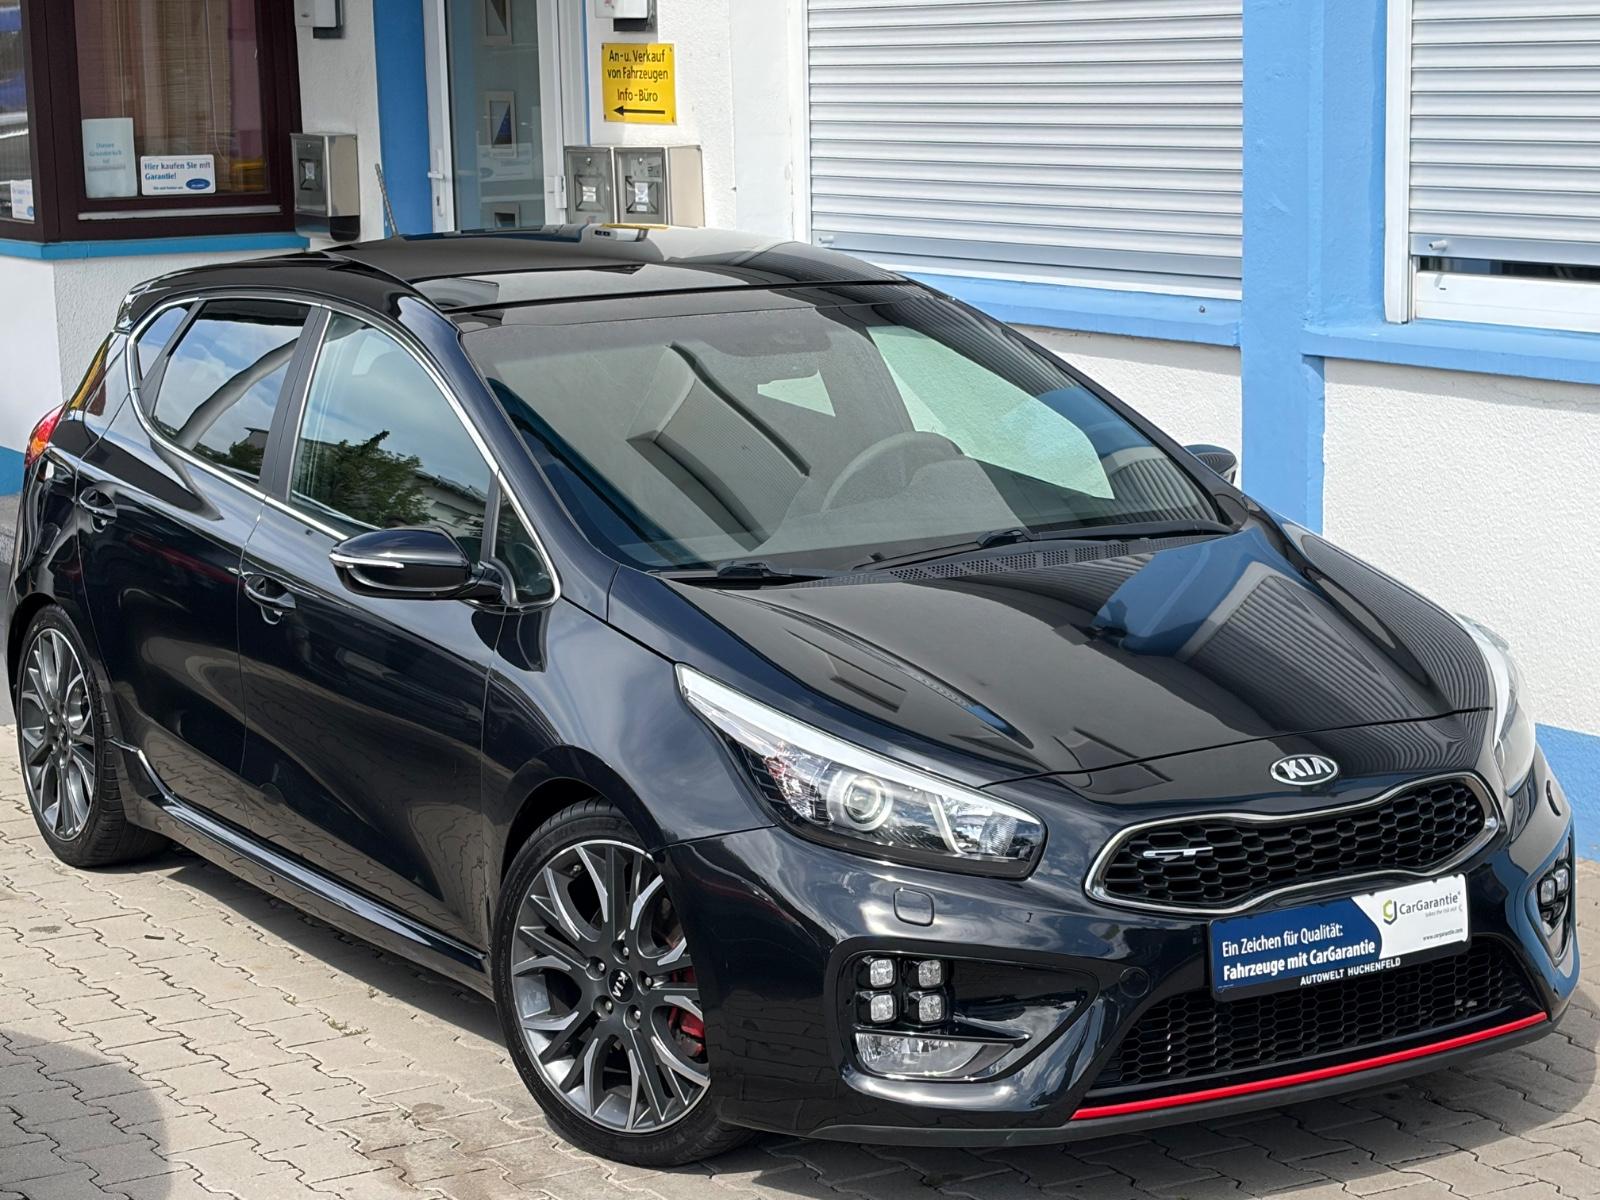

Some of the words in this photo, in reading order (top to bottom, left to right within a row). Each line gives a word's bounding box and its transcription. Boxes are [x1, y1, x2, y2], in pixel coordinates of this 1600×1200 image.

[632, 48, 666, 63] Verkauf
[607, 68, 621, 79] von
[622, 66, 669, 83] Fahrzeugen
[144, 162, 159, 170] Hier
[160, 162, 185, 170] kaufen
[186, 161, 198, 169] Sie
[199, 161, 211, 169] mit
[1279, 757, 1332, 779] KIA
[1399, 892, 1459, 915] CarGarantie
[1222, 941, 1239, 957] Ein
[1240, 934, 1281, 954] Zeichen
[1283, 930, 1299, 946] für
[1300, 922, 1344, 945] Qualität:
[1223, 959, 1285, 981] Fahrzeuge
[1287, 952, 1308, 969] mit
[1309, 938, 1376, 965] CarGarantie
[1300, 968, 1345, 986] AUTOWELT
[1347, 957, 1401, 977] HUCHENFELD
[612, 971, 629, 997] KIA
